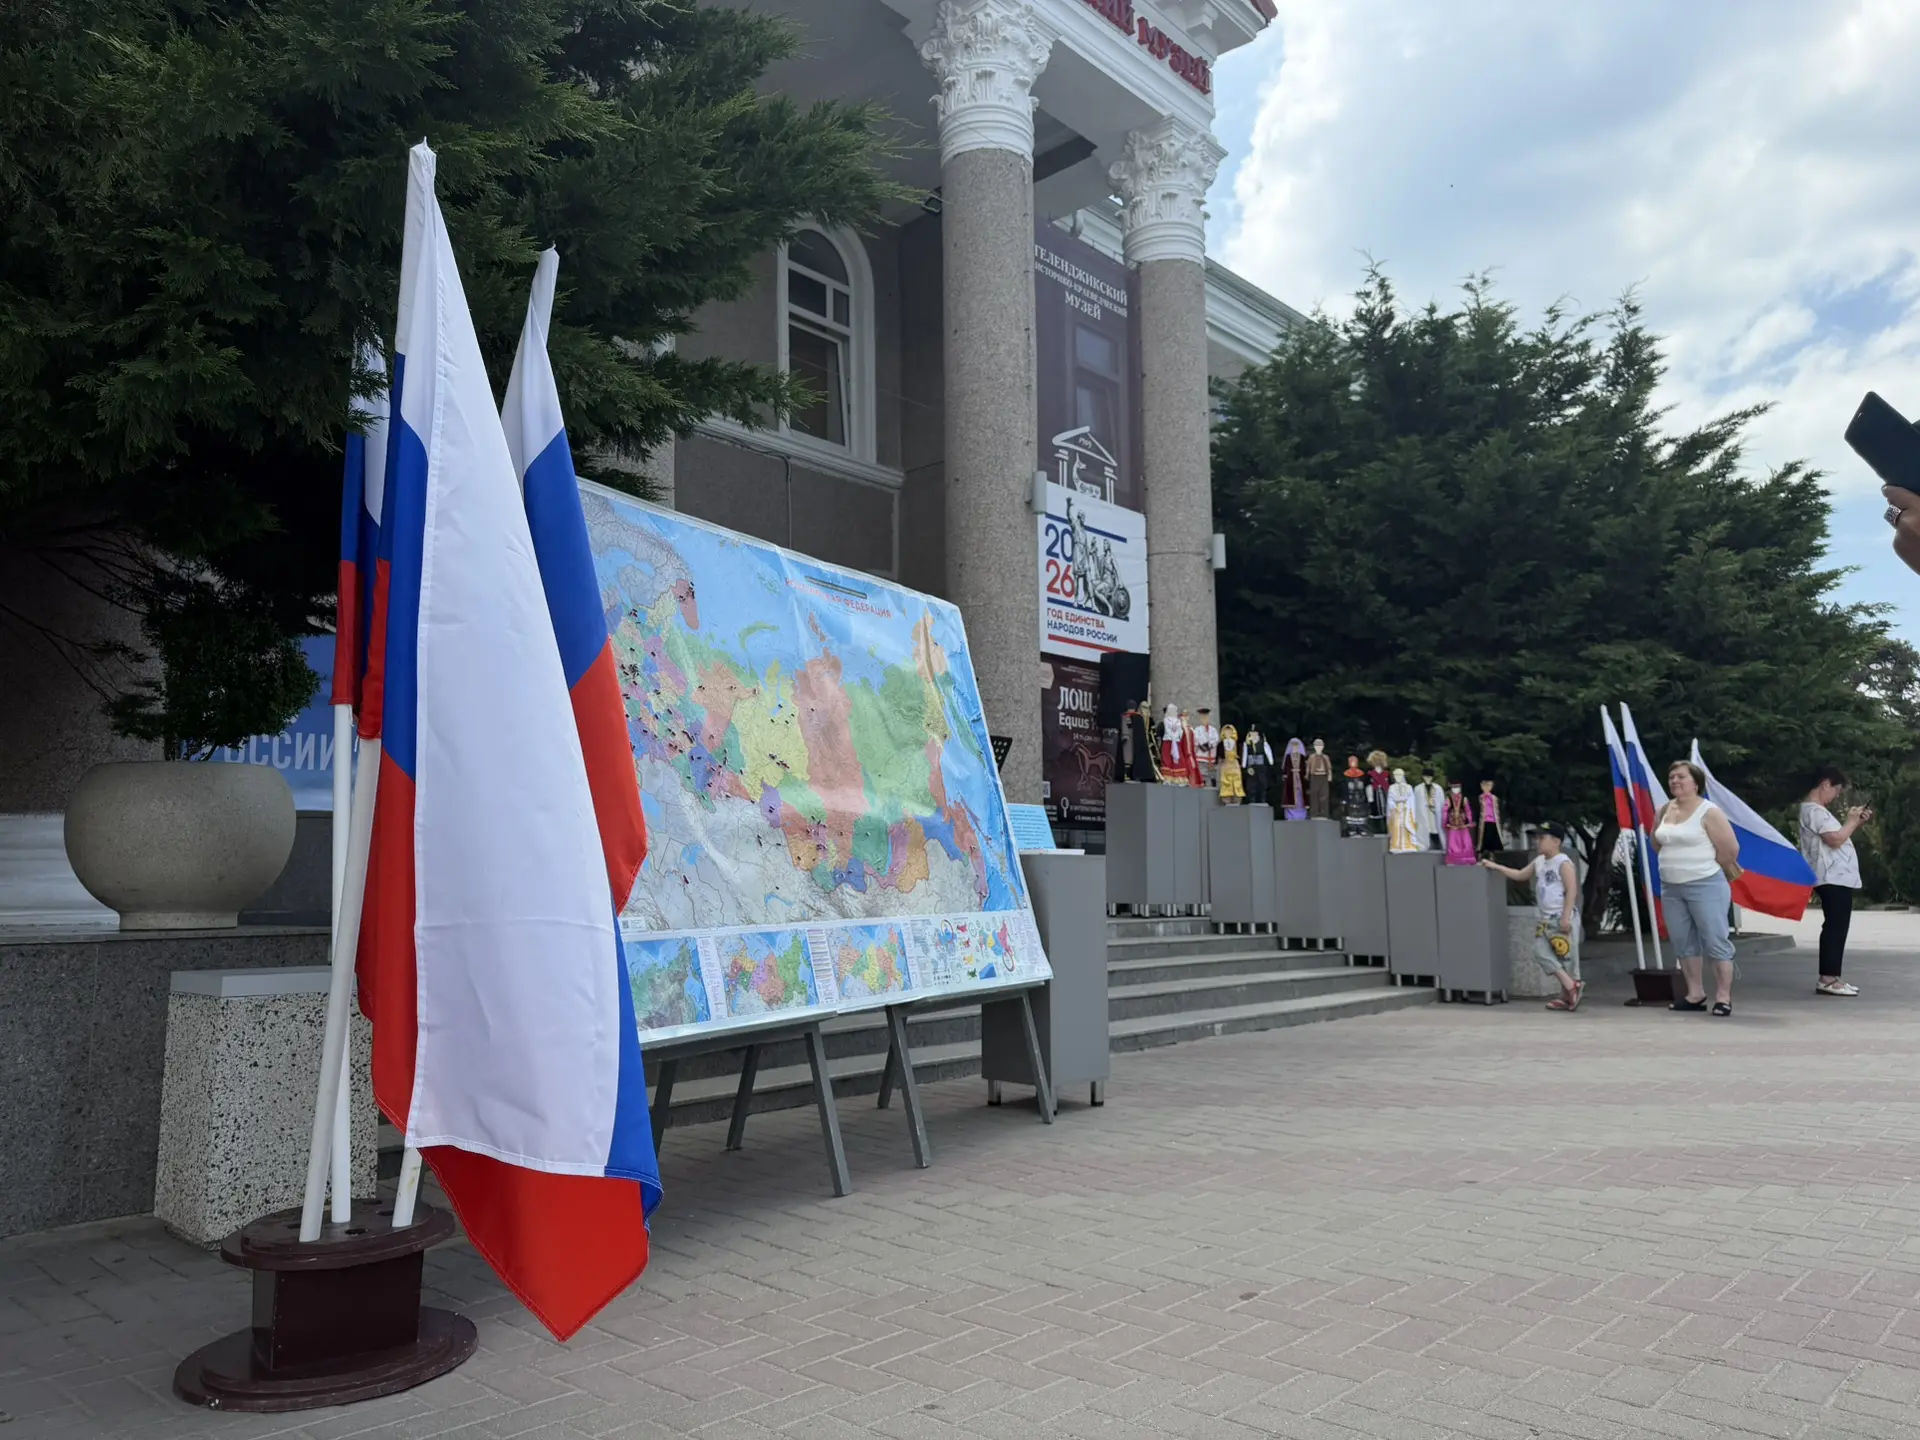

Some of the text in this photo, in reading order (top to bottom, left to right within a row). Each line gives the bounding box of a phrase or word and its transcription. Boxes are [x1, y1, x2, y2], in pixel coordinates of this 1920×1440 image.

[1034, 244, 1128, 306] ГЕЛЕНДЖИКСКИЙ
[1065, 291, 1101, 320] МУЗЕЙ
[1045, 523, 1073, 563] 20
[1046, 559, 1075, 598] 26
[1047, 608, 1105, 629] ГОД ЕДИНСТВА
[1047, 620, 1118, 643] НАРОДОВ РОССИИ
[1057, 686, 1100, 716] ЛОШ
[1059, 712, 1090, 730] Equus
